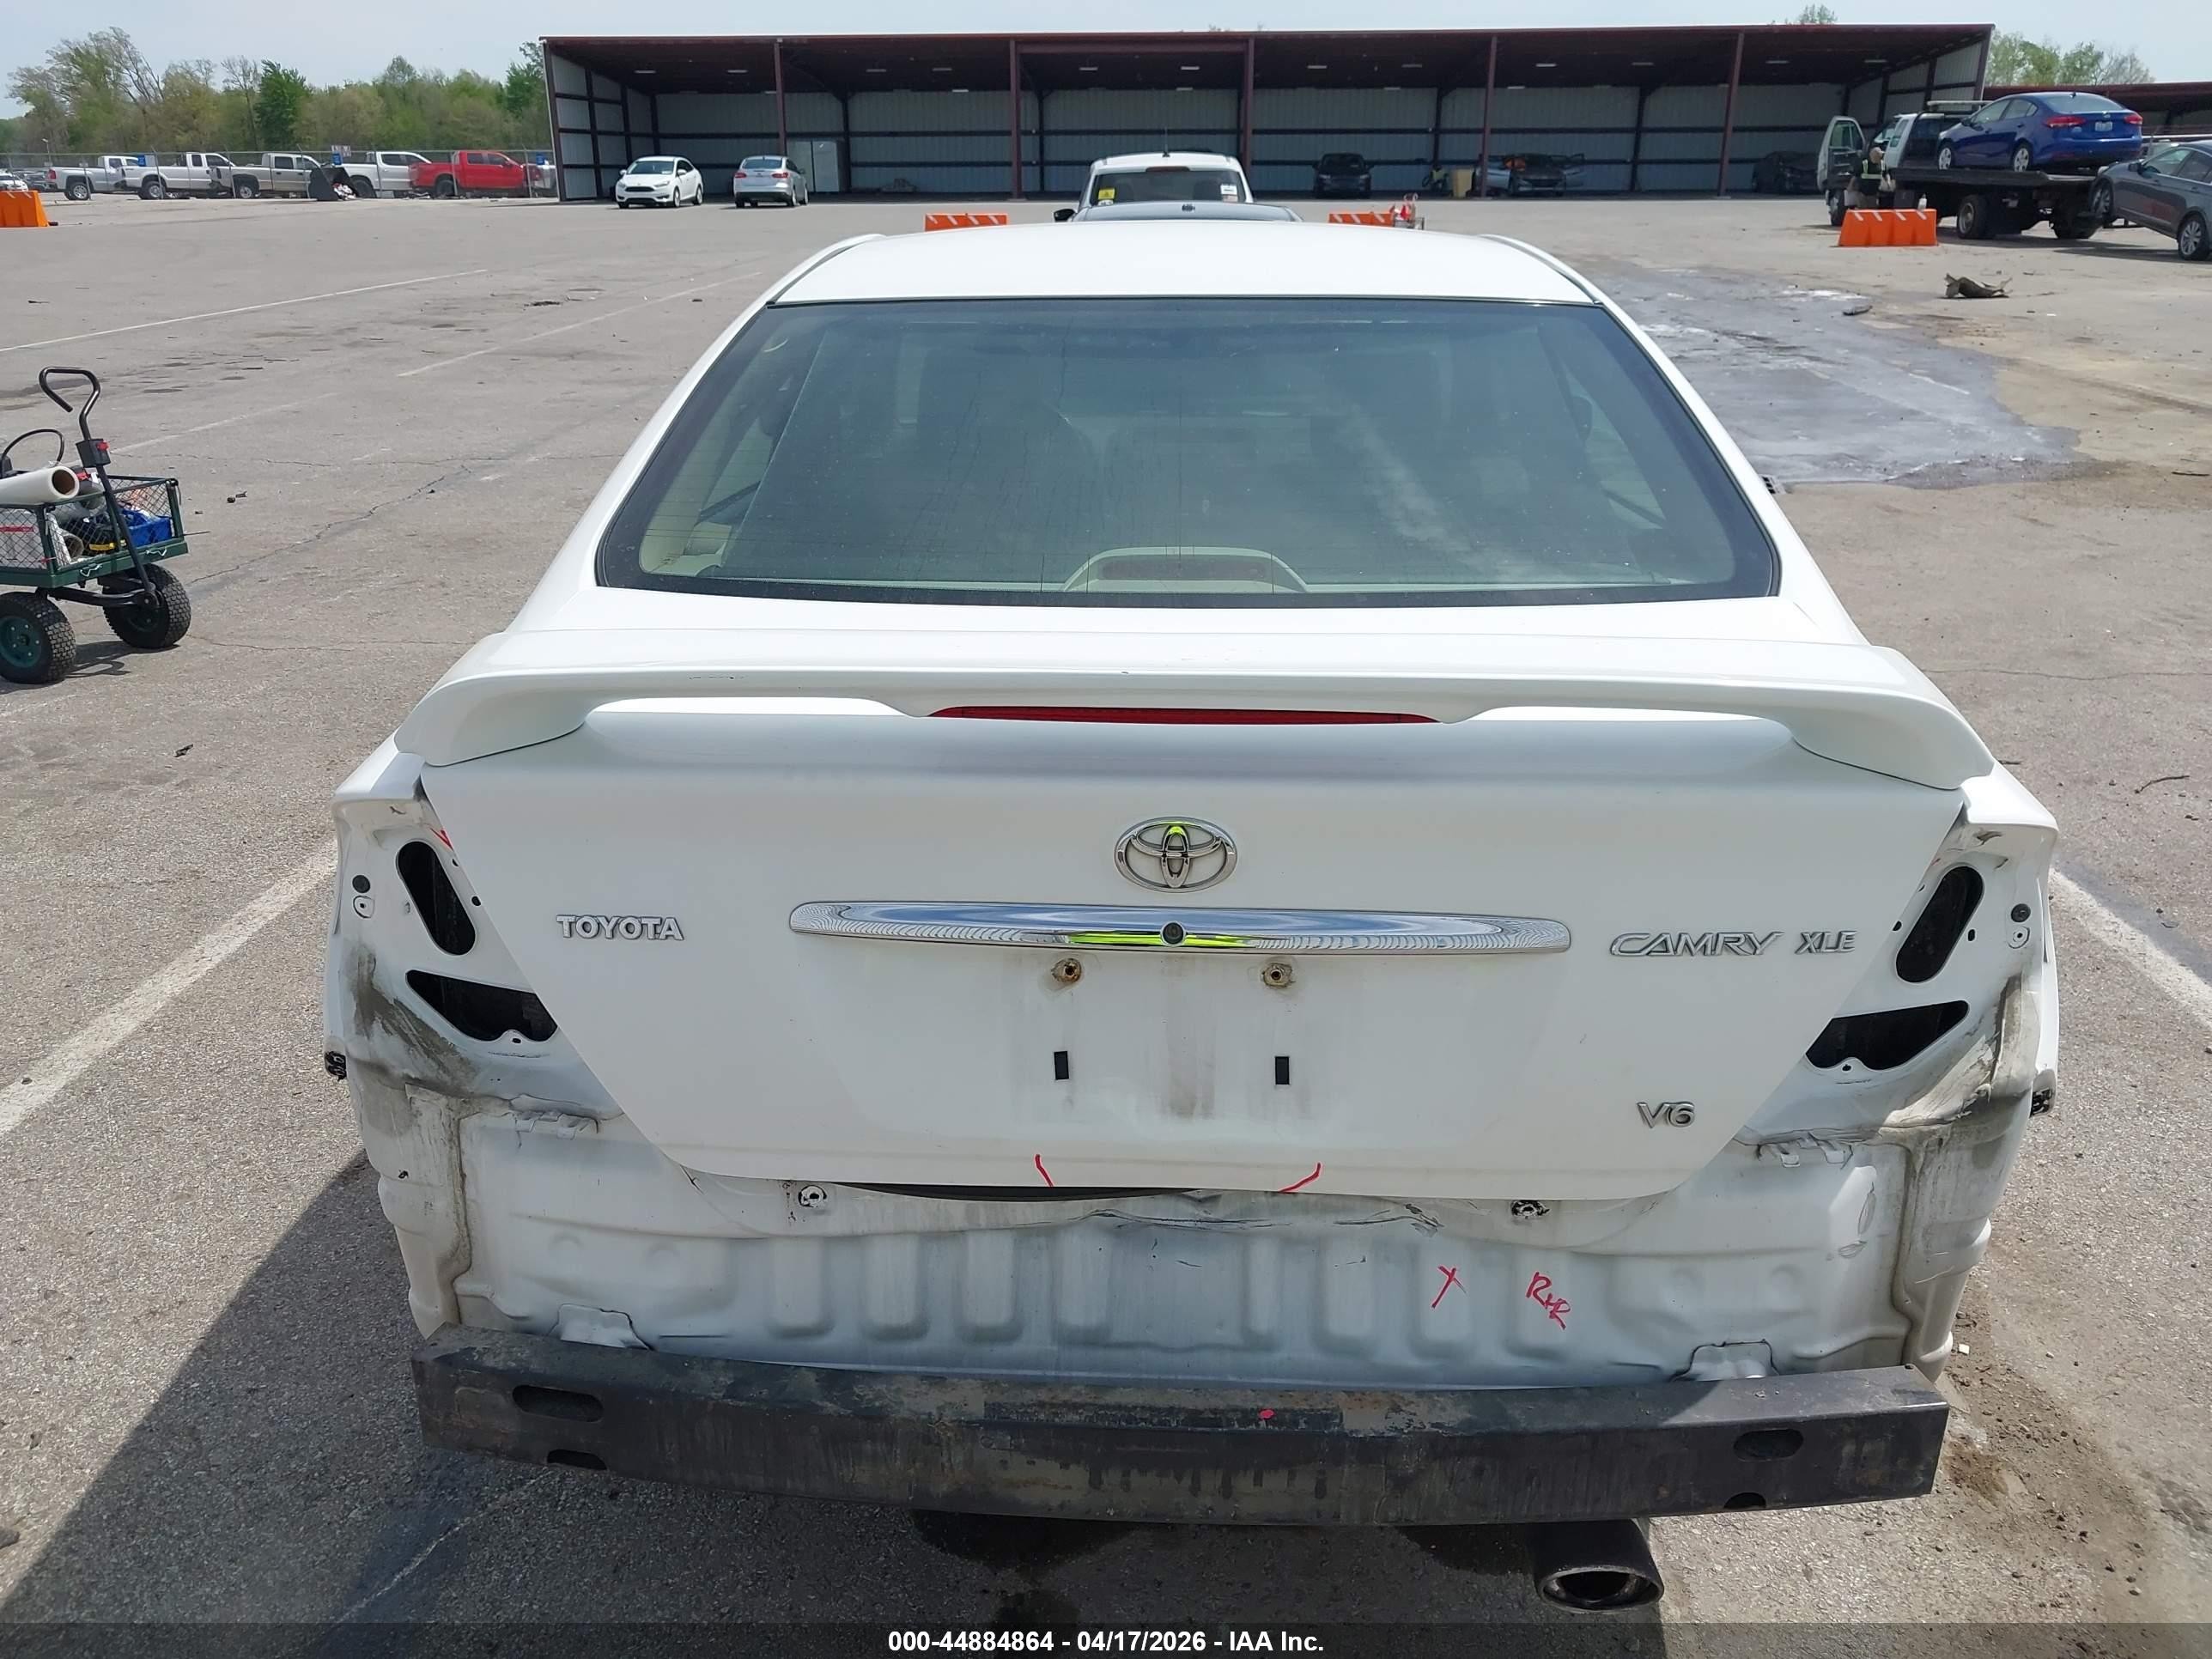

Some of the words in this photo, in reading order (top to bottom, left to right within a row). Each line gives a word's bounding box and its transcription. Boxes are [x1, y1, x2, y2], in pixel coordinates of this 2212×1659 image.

[556, 914, 685, 941] TOYOTA
[1609, 932, 1784, 957] CAMRY
[1795, 931, 1857, 955] XLE
[1636, 1101, 1696, 1129] V6
